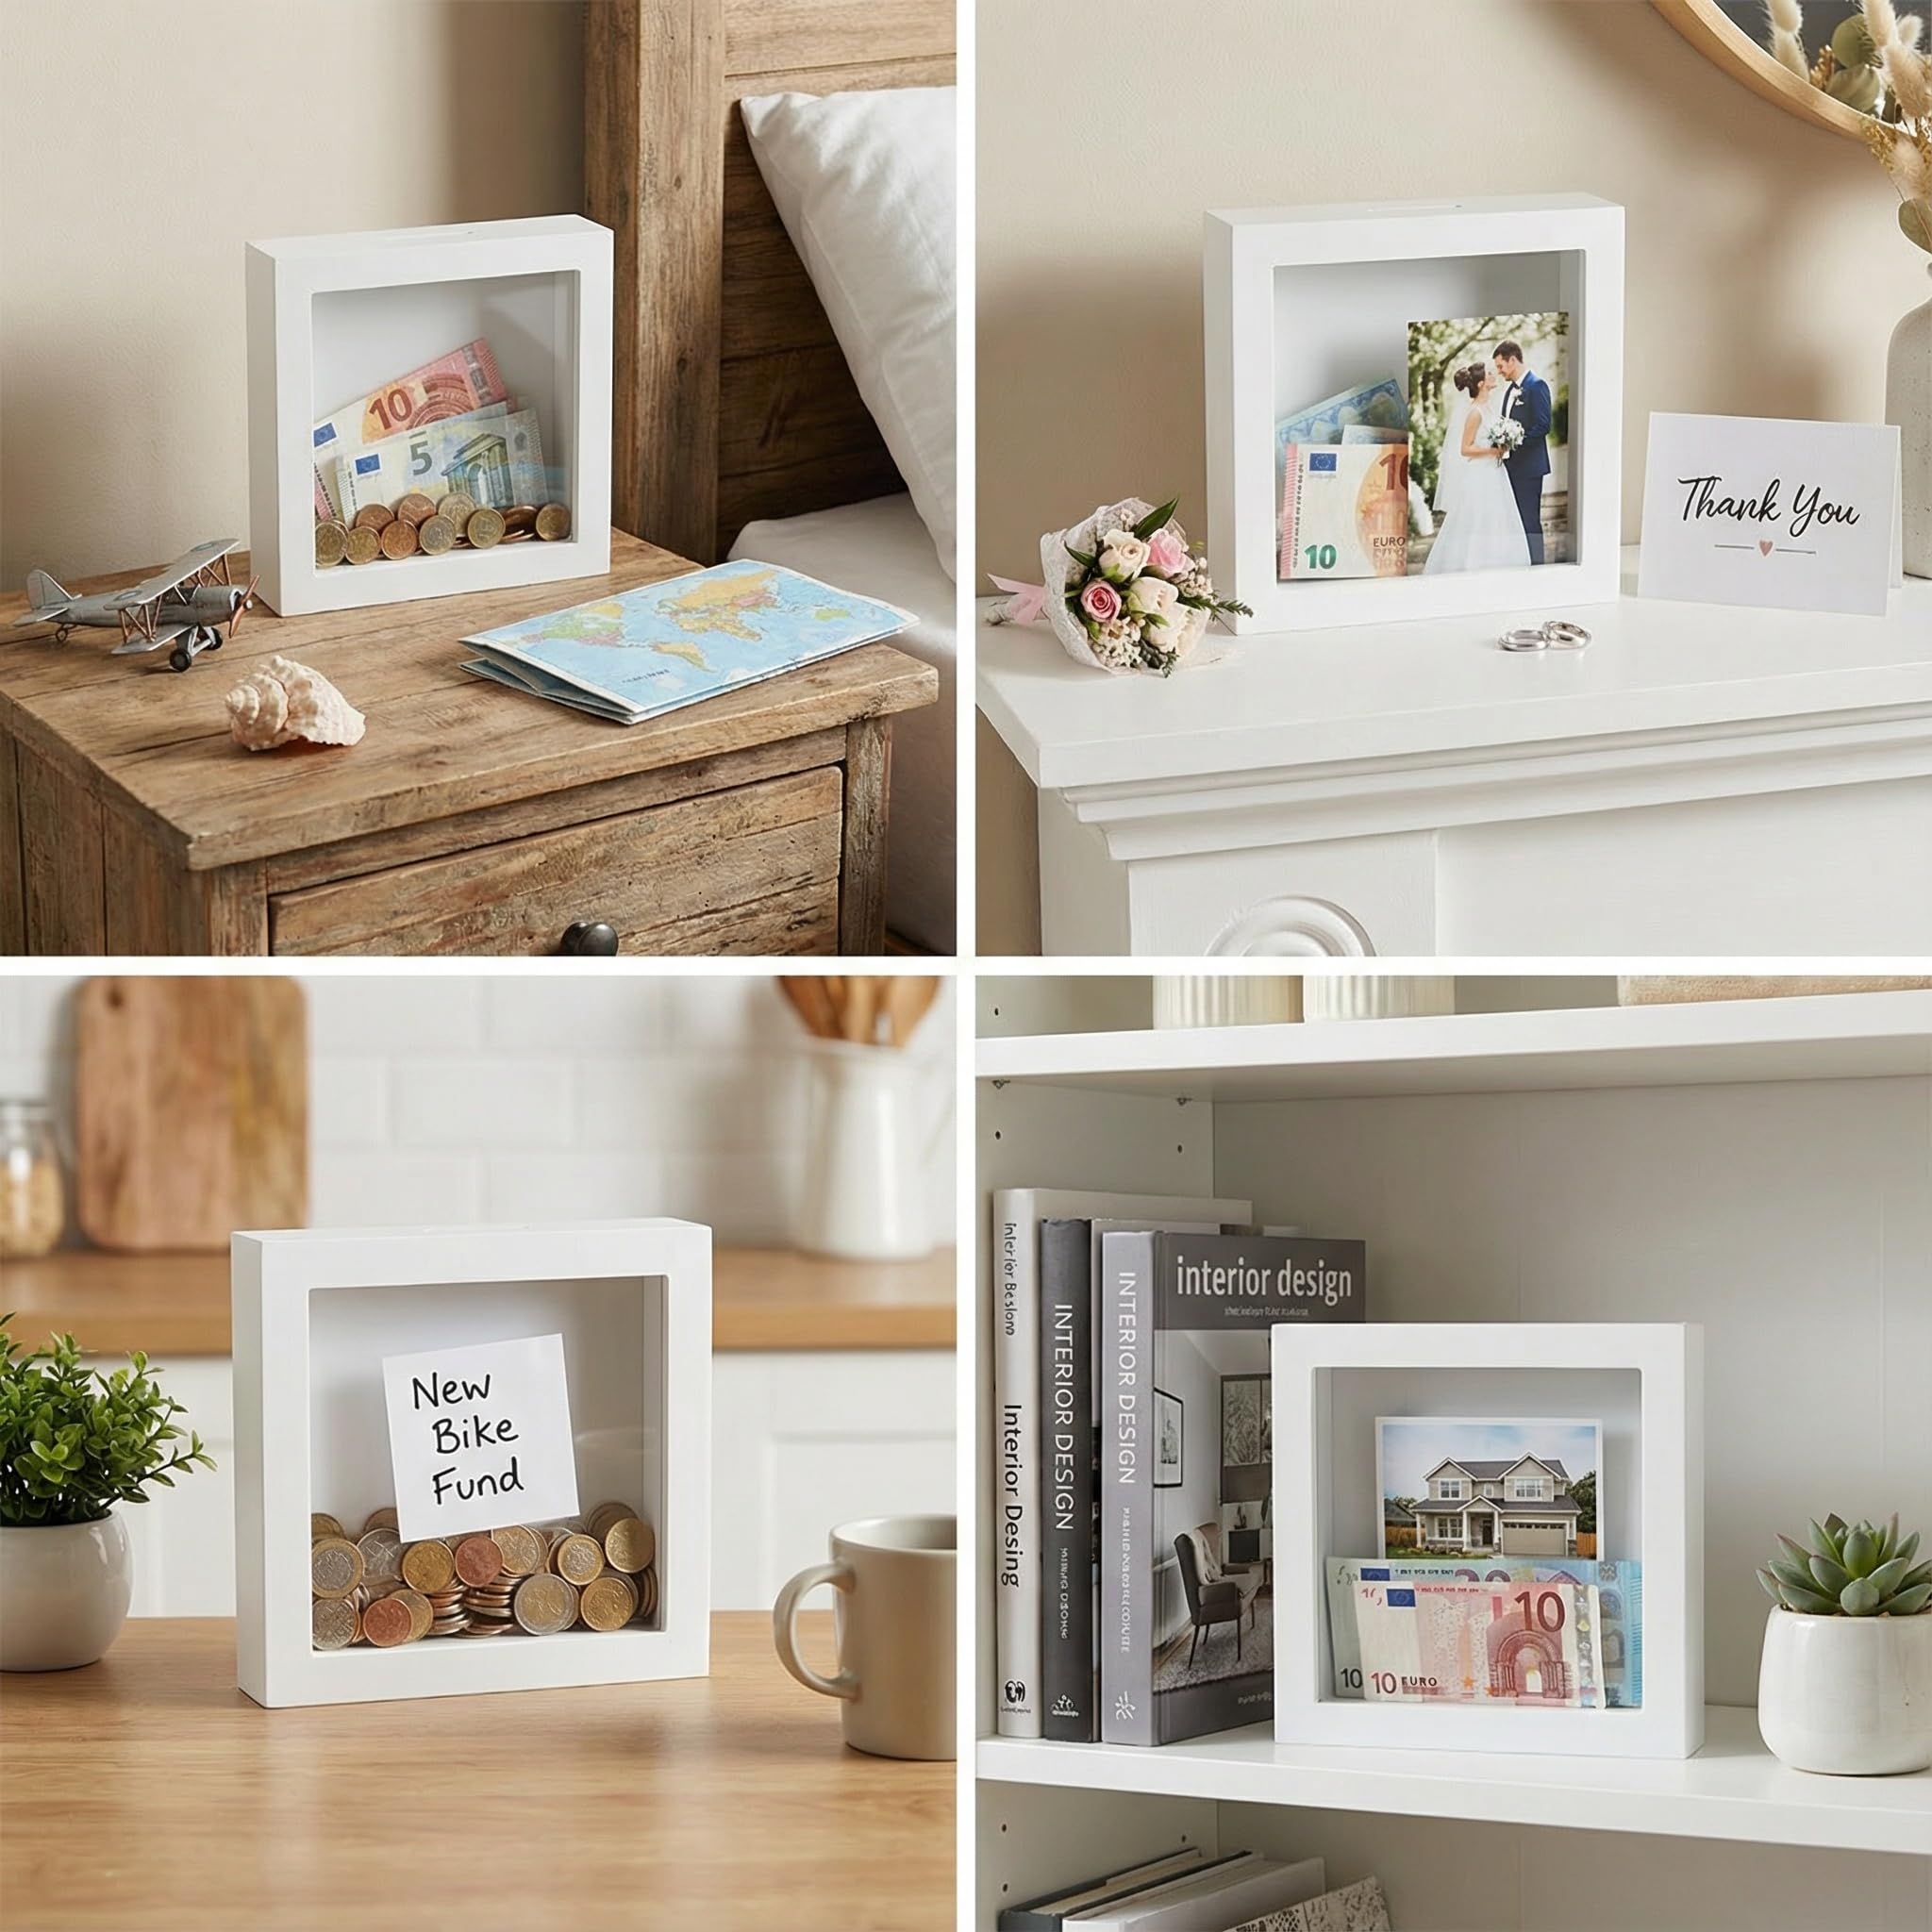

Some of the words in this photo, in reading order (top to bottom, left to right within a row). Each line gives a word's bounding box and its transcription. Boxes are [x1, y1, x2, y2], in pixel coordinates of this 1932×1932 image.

[369, 389, 412, 430] 10
[409, 441, 432, 476] 5
[1677, 475, 1781, 523] Thank
[1790, 484, 1860, 537] You
[1304, 544, 1337, 570] 10
[1374, 536, 1406, 547] EURO
[1177, 1256, 1271, 1295] interior
[1277, 1258, 1352, 1306] design
[1118, 1272, 1137, 1386] INTERIOR
[1055, 1305, 1074, 1424] INTERIOR
[412, 1372, 491, 1409] New
[432, 1415, 519, 1454] Bike
[1004, 1405, 1023, 1496] Interior
[1119, 1394, 1136, 1484] DESIGN
[432, 1457, 525, 1505] Fund
[1055, 1434, 1074, 1530] DESIGN
[1001, 1505, 1024, 1588] Desing
[1514, 1591, 1566, 1633] 10
[1341, 1668, 1363, 1689] 10
[1371, 1673, 1397, 1694] 10
[1401, 1675, 1437, 1687] EURO
